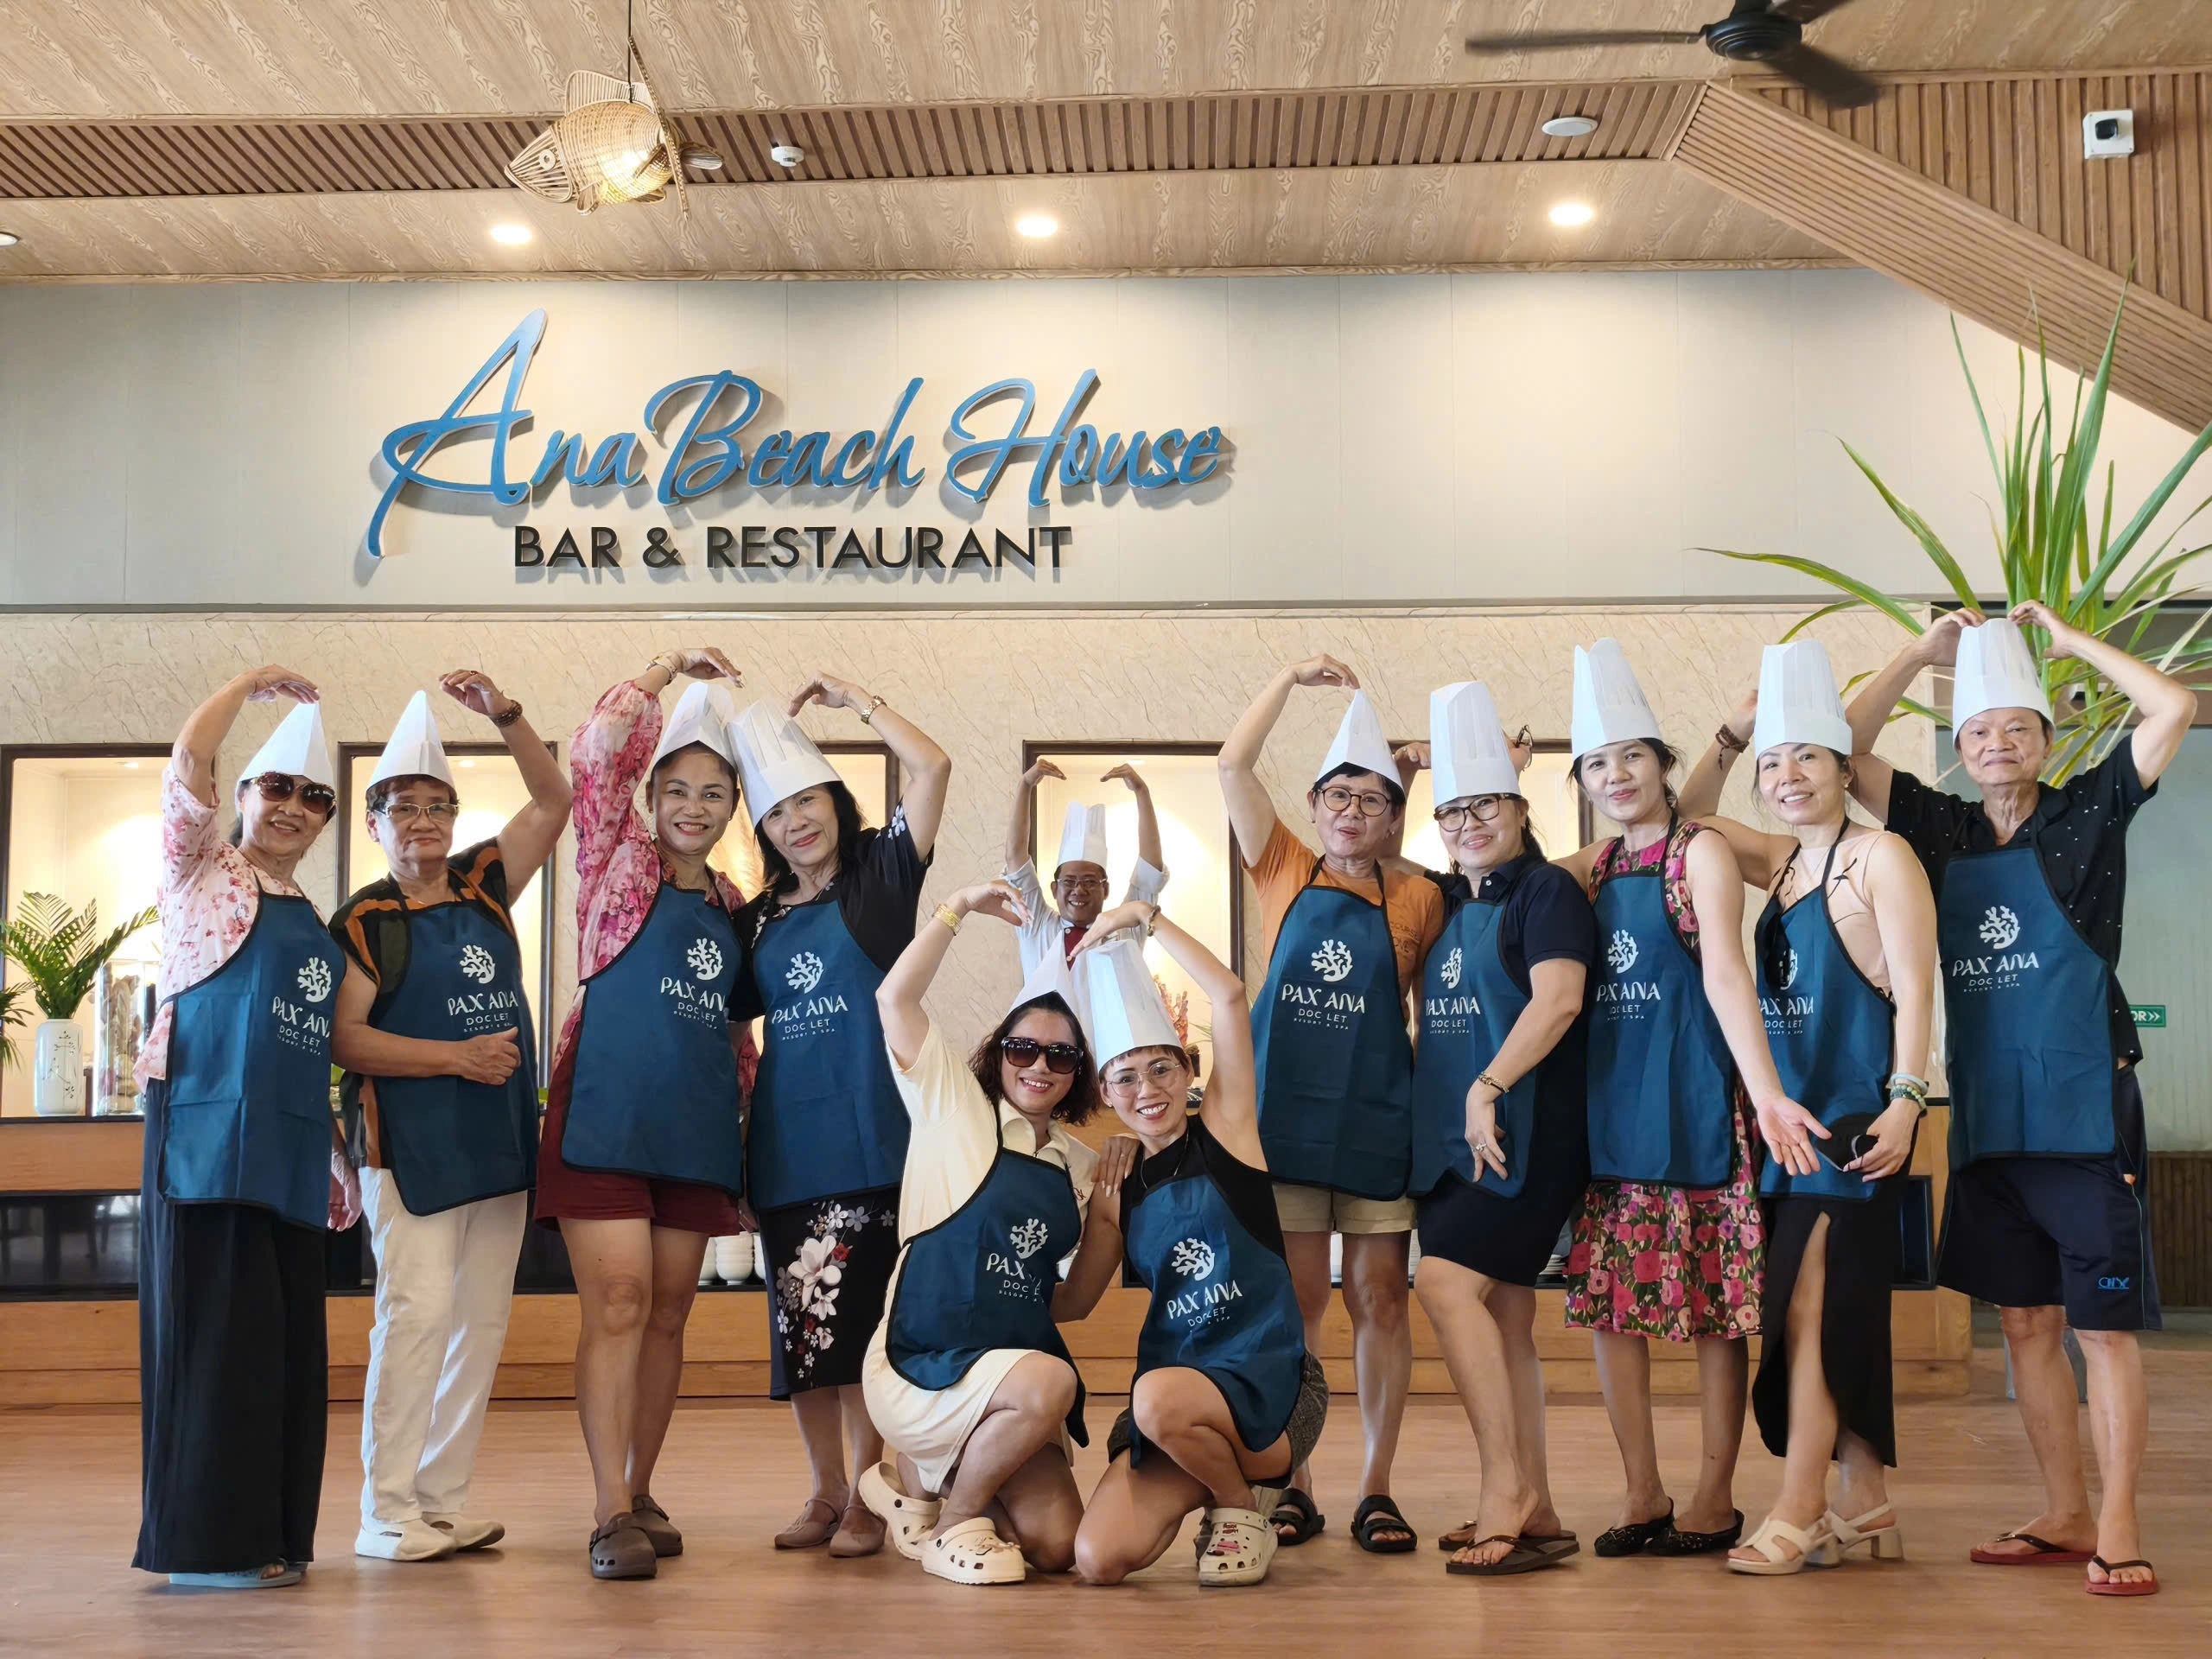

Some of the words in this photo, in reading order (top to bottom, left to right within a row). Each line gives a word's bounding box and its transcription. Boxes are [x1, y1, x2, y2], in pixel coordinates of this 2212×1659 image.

[366, 308, 641, 557] Ana
[644, 370, 925, 505] Beach
[948, 369, 1222, 505] House
[513, 526, 619, 568] BAR
[642, 526, 681, 568] &
[707, 526, 1071, 568] RESTAURANT
[1952, 956, 1993, 977] PAX
[1996, 951, 2039, 973] ANA
[1620, 982, 1662, 1001] ANA
[1968, 977, 1993, 987] DOC
[1998, 974, 2018, 983] LET
[448, 995, 486, 1016] PAX
[489, 990, 518, 1011] ANA
[660, 976, 696, 1001] PAX
[699, 990, 726, 1012] AN
[1281, 983, 1322, 1007] PAX
[1324, 991, 1365, 1014] ANA
[272, 995, 302, 1026] PAX
[303, 1013, 330, 1038] AN
[677, 1001, 699, 1014] DOC
[701, 1010, 717, 1022] LET
[772, 1001, 803, 1024] PAX
[806, 995, 849, 1017] ANA
[1299, 1008, 1322, 1019] DOC
[1326, 1012, 1348, 1024] LET
[1426, 996, 1448, 1017] PAX
[1451, 995, 1481, 1015] ANA
[1623, 1004, 1642, 1013] LET
[1758, 998, 1782, 1015] AX
[466, 1014, 492, 1026] DOC
[493, 1012, 509, 1021] LET
[785, 1022, 806, 1033] DOC
[810, 1019, 830, 1028] LET
[1431, 1019, 1450, 1028] DOC
[1452, 1019, 1466, 1028] LET
[1764, 1020, 1785, 1028] DOC
[1788, 1019, 1803, 1028] LET
[279, 1025, 300, 1039] DOC
[302, 1035, 321, 1047] LET
[986, 1253, 1026, 1280] PAX
[1003, 1280, 1029, 1293] DOC
[1166, 1291, 1200, 1319] PAX
[1205, 1280, 1243, 1306] ANA
